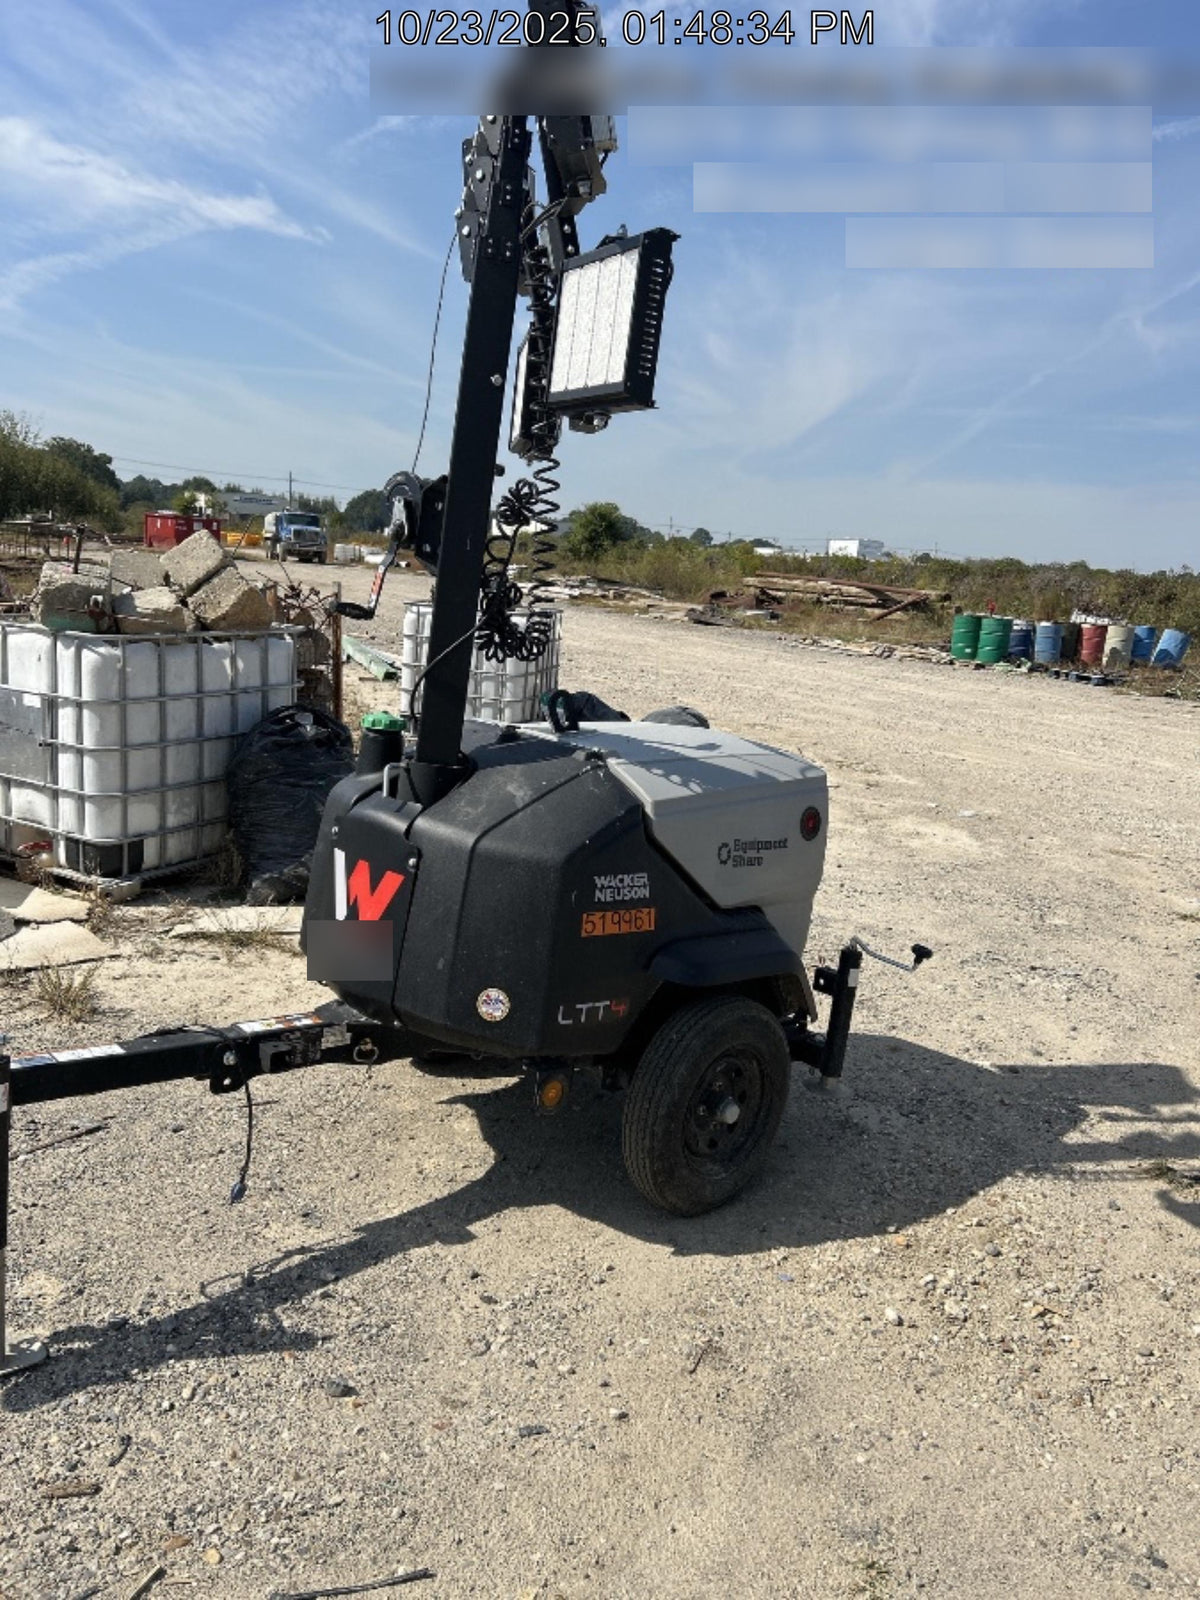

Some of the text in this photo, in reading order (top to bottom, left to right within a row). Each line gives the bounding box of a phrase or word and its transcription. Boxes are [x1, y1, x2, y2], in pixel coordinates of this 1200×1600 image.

[593, 872, 649, 888] WACKER
[594, 885, 650, 902] NEUSON
[584, 909, 653, 934] 519961
